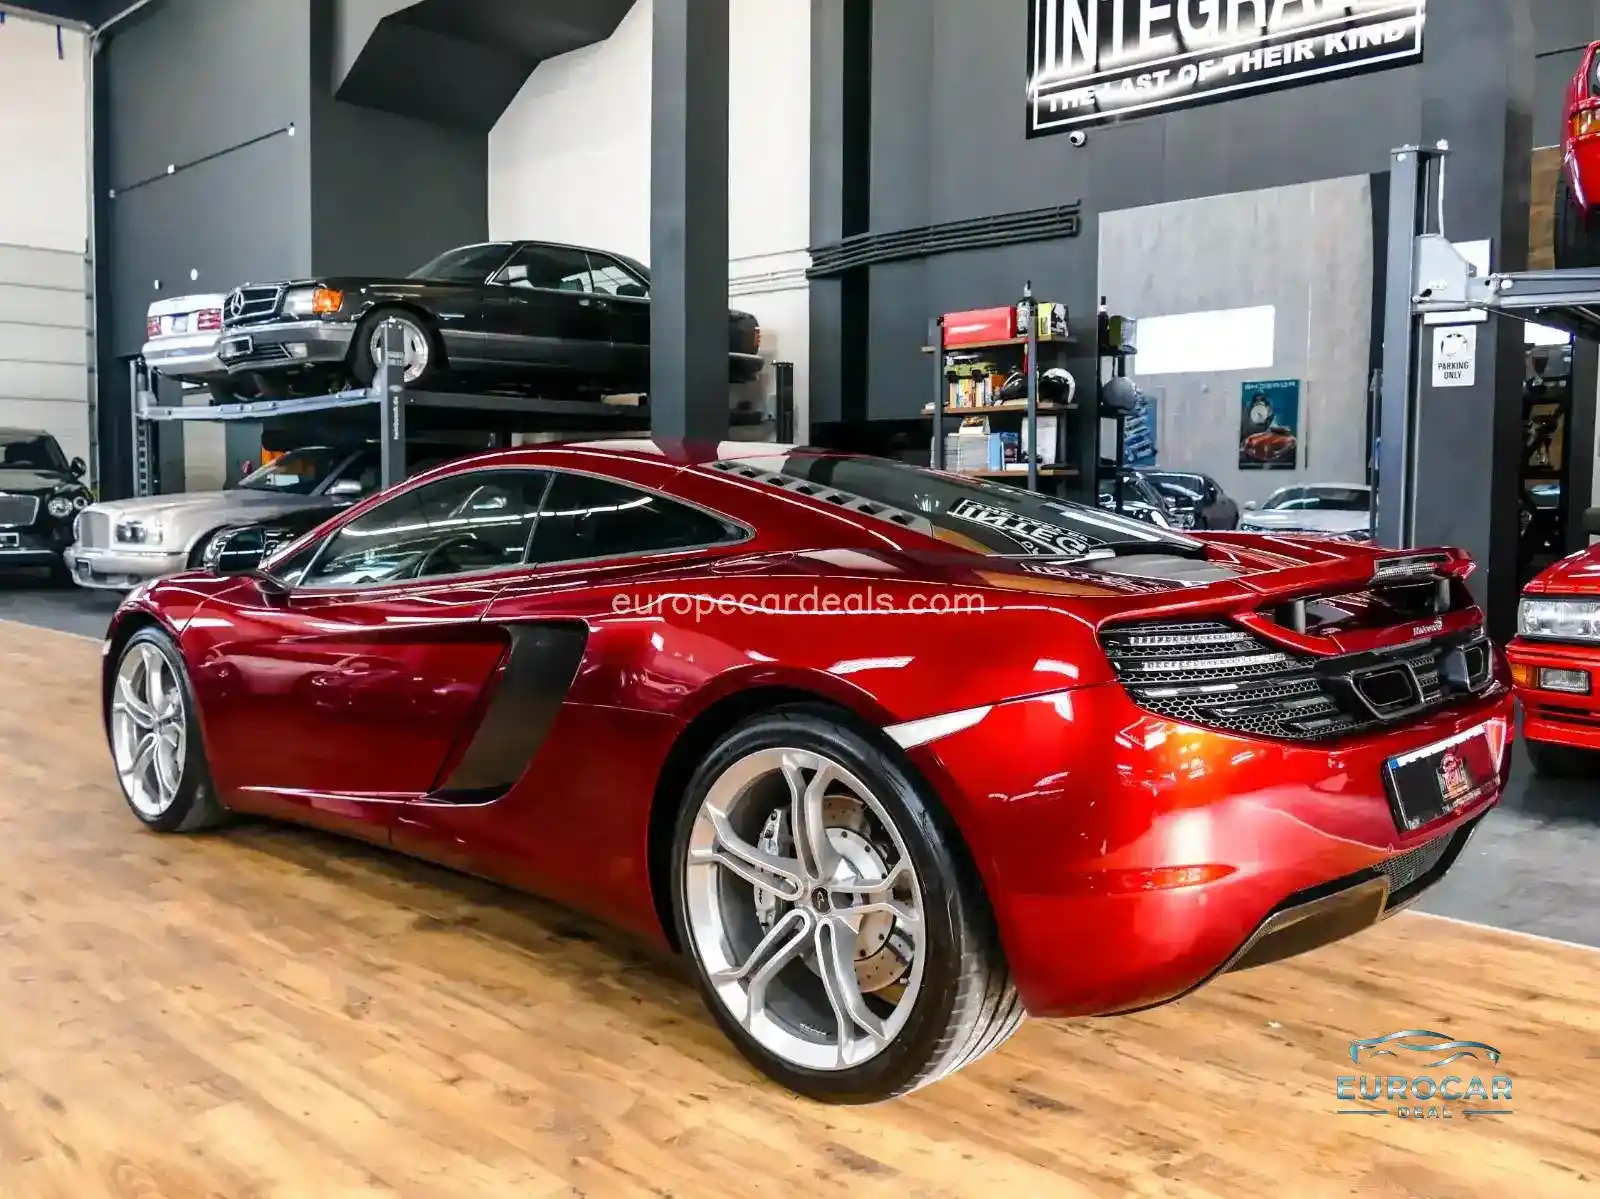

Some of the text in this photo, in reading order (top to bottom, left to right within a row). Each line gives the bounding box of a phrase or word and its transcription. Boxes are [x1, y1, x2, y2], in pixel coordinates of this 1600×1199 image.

[1177, 59, 1216, 88] OF
[1223, 39, 1315, 76] THEIR
[1323, 22, 1405, 56] KIND
[1438, 361, 1469, 370] PARKING
[1443, 371, 1461, 379] ONLY
